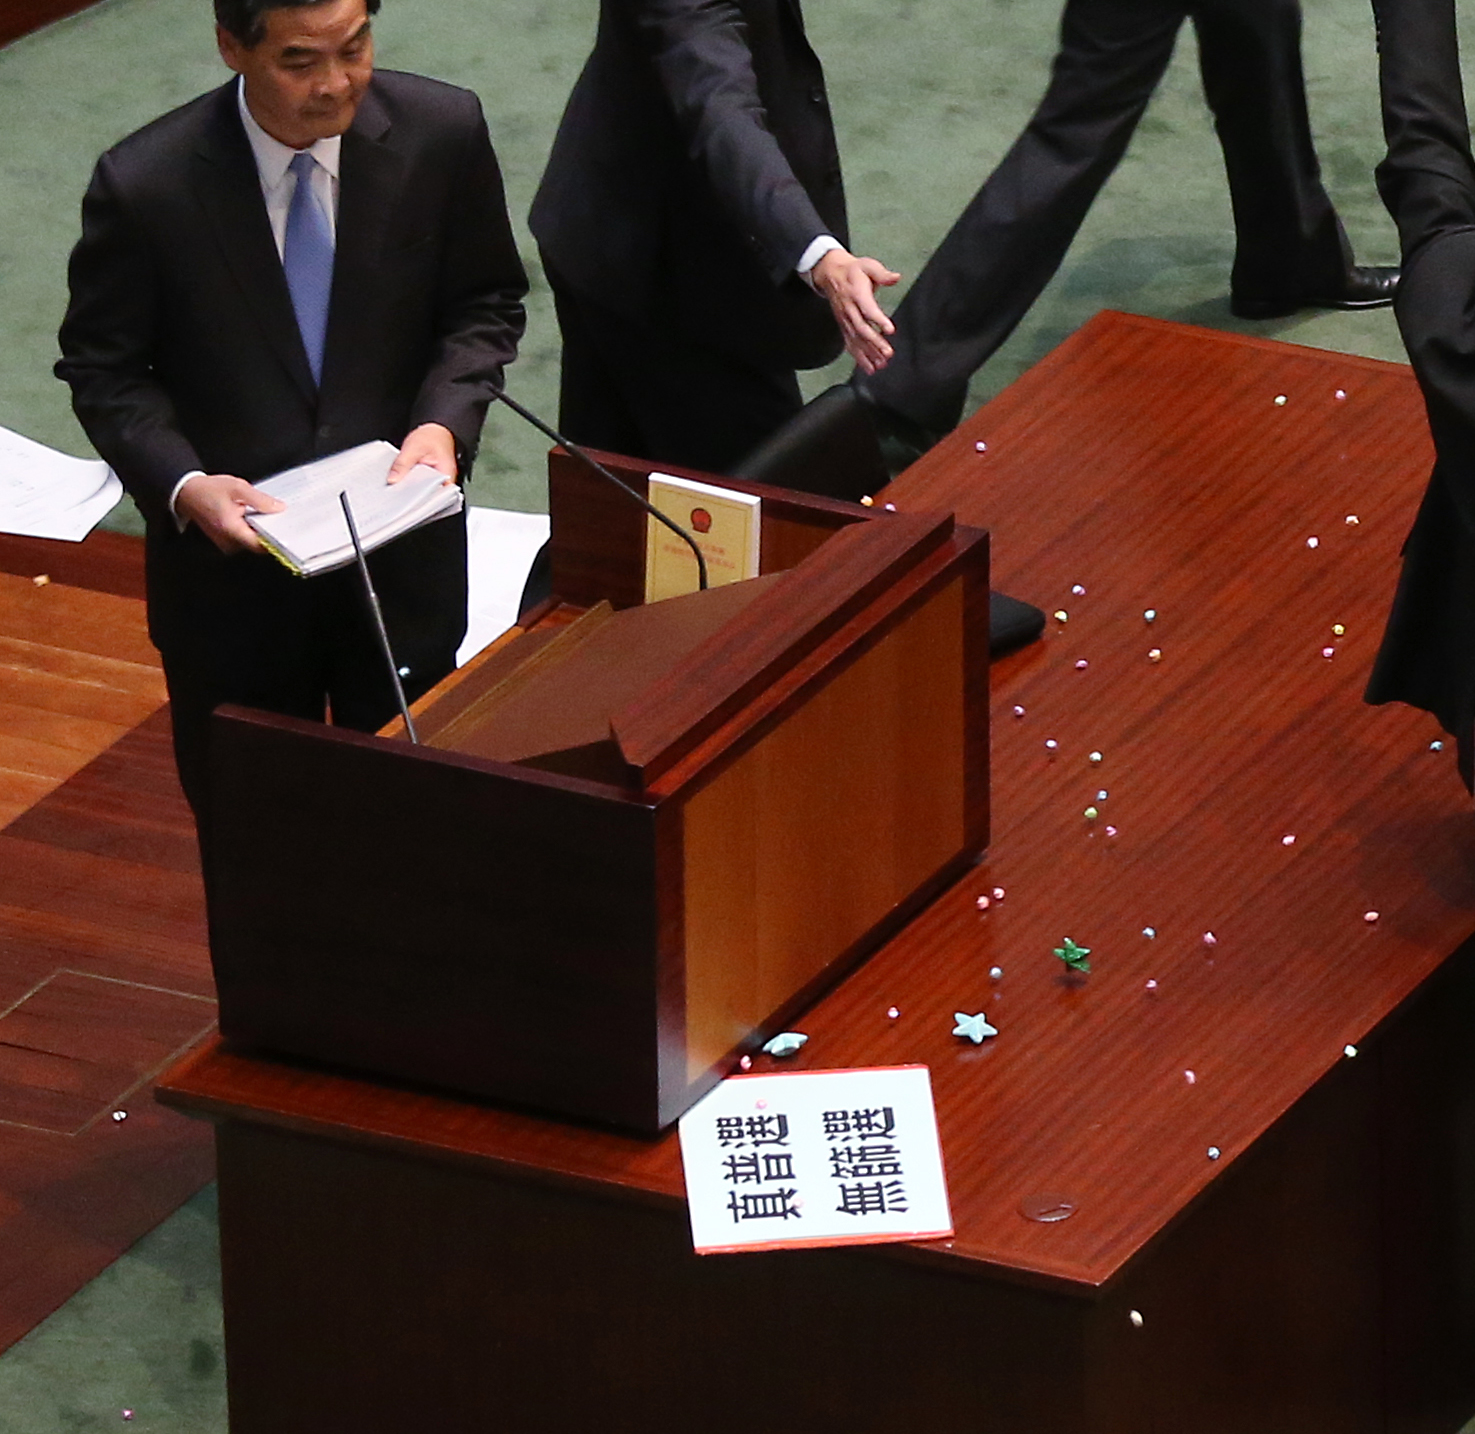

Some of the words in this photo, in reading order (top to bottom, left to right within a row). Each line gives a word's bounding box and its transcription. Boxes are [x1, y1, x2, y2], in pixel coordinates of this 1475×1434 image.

[716, 1113, 802, 1223] 真普選
[822, 1106, 909, 1215] 無篩選
